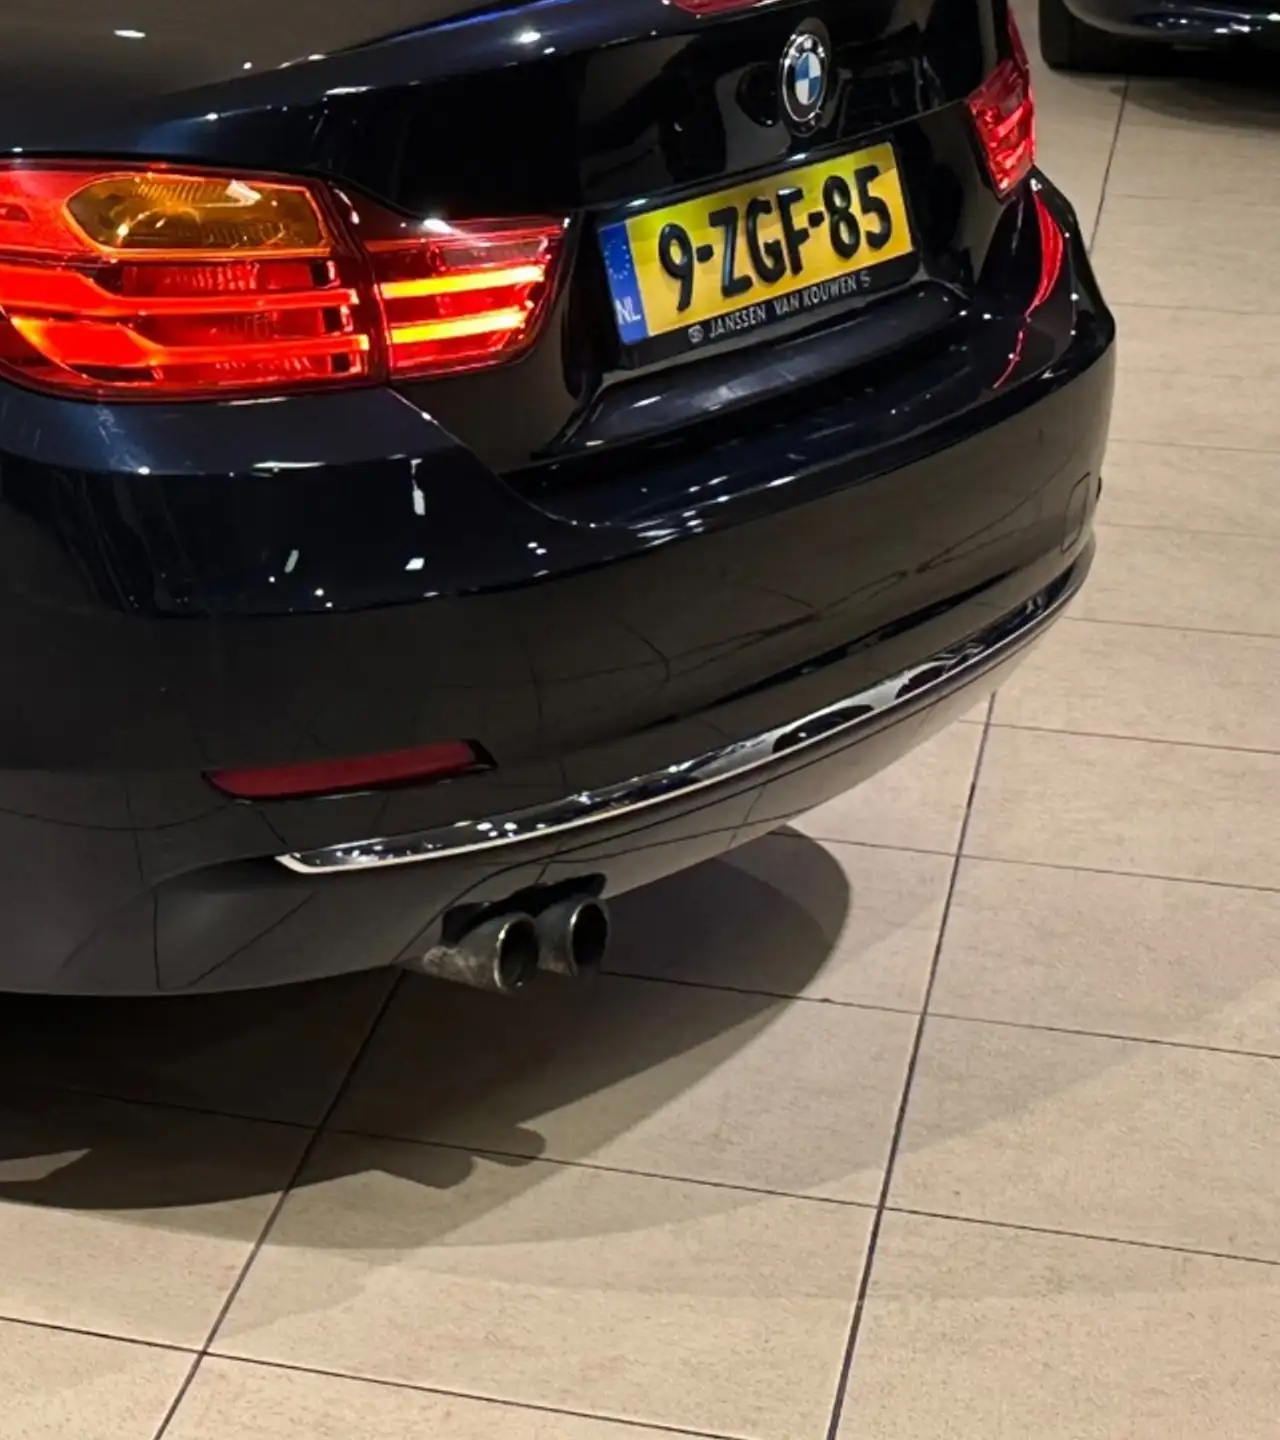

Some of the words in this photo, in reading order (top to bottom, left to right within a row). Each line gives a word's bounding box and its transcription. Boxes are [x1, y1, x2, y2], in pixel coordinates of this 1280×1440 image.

[658, 164, 892, 312] 9-ZGF-85
[615, 296, 642, 325] NL
[709, 305, 766, 338] JANSSEN
[772, 292, 800, 315] VAN
[803, 274, 857, 307] KOUWEN
